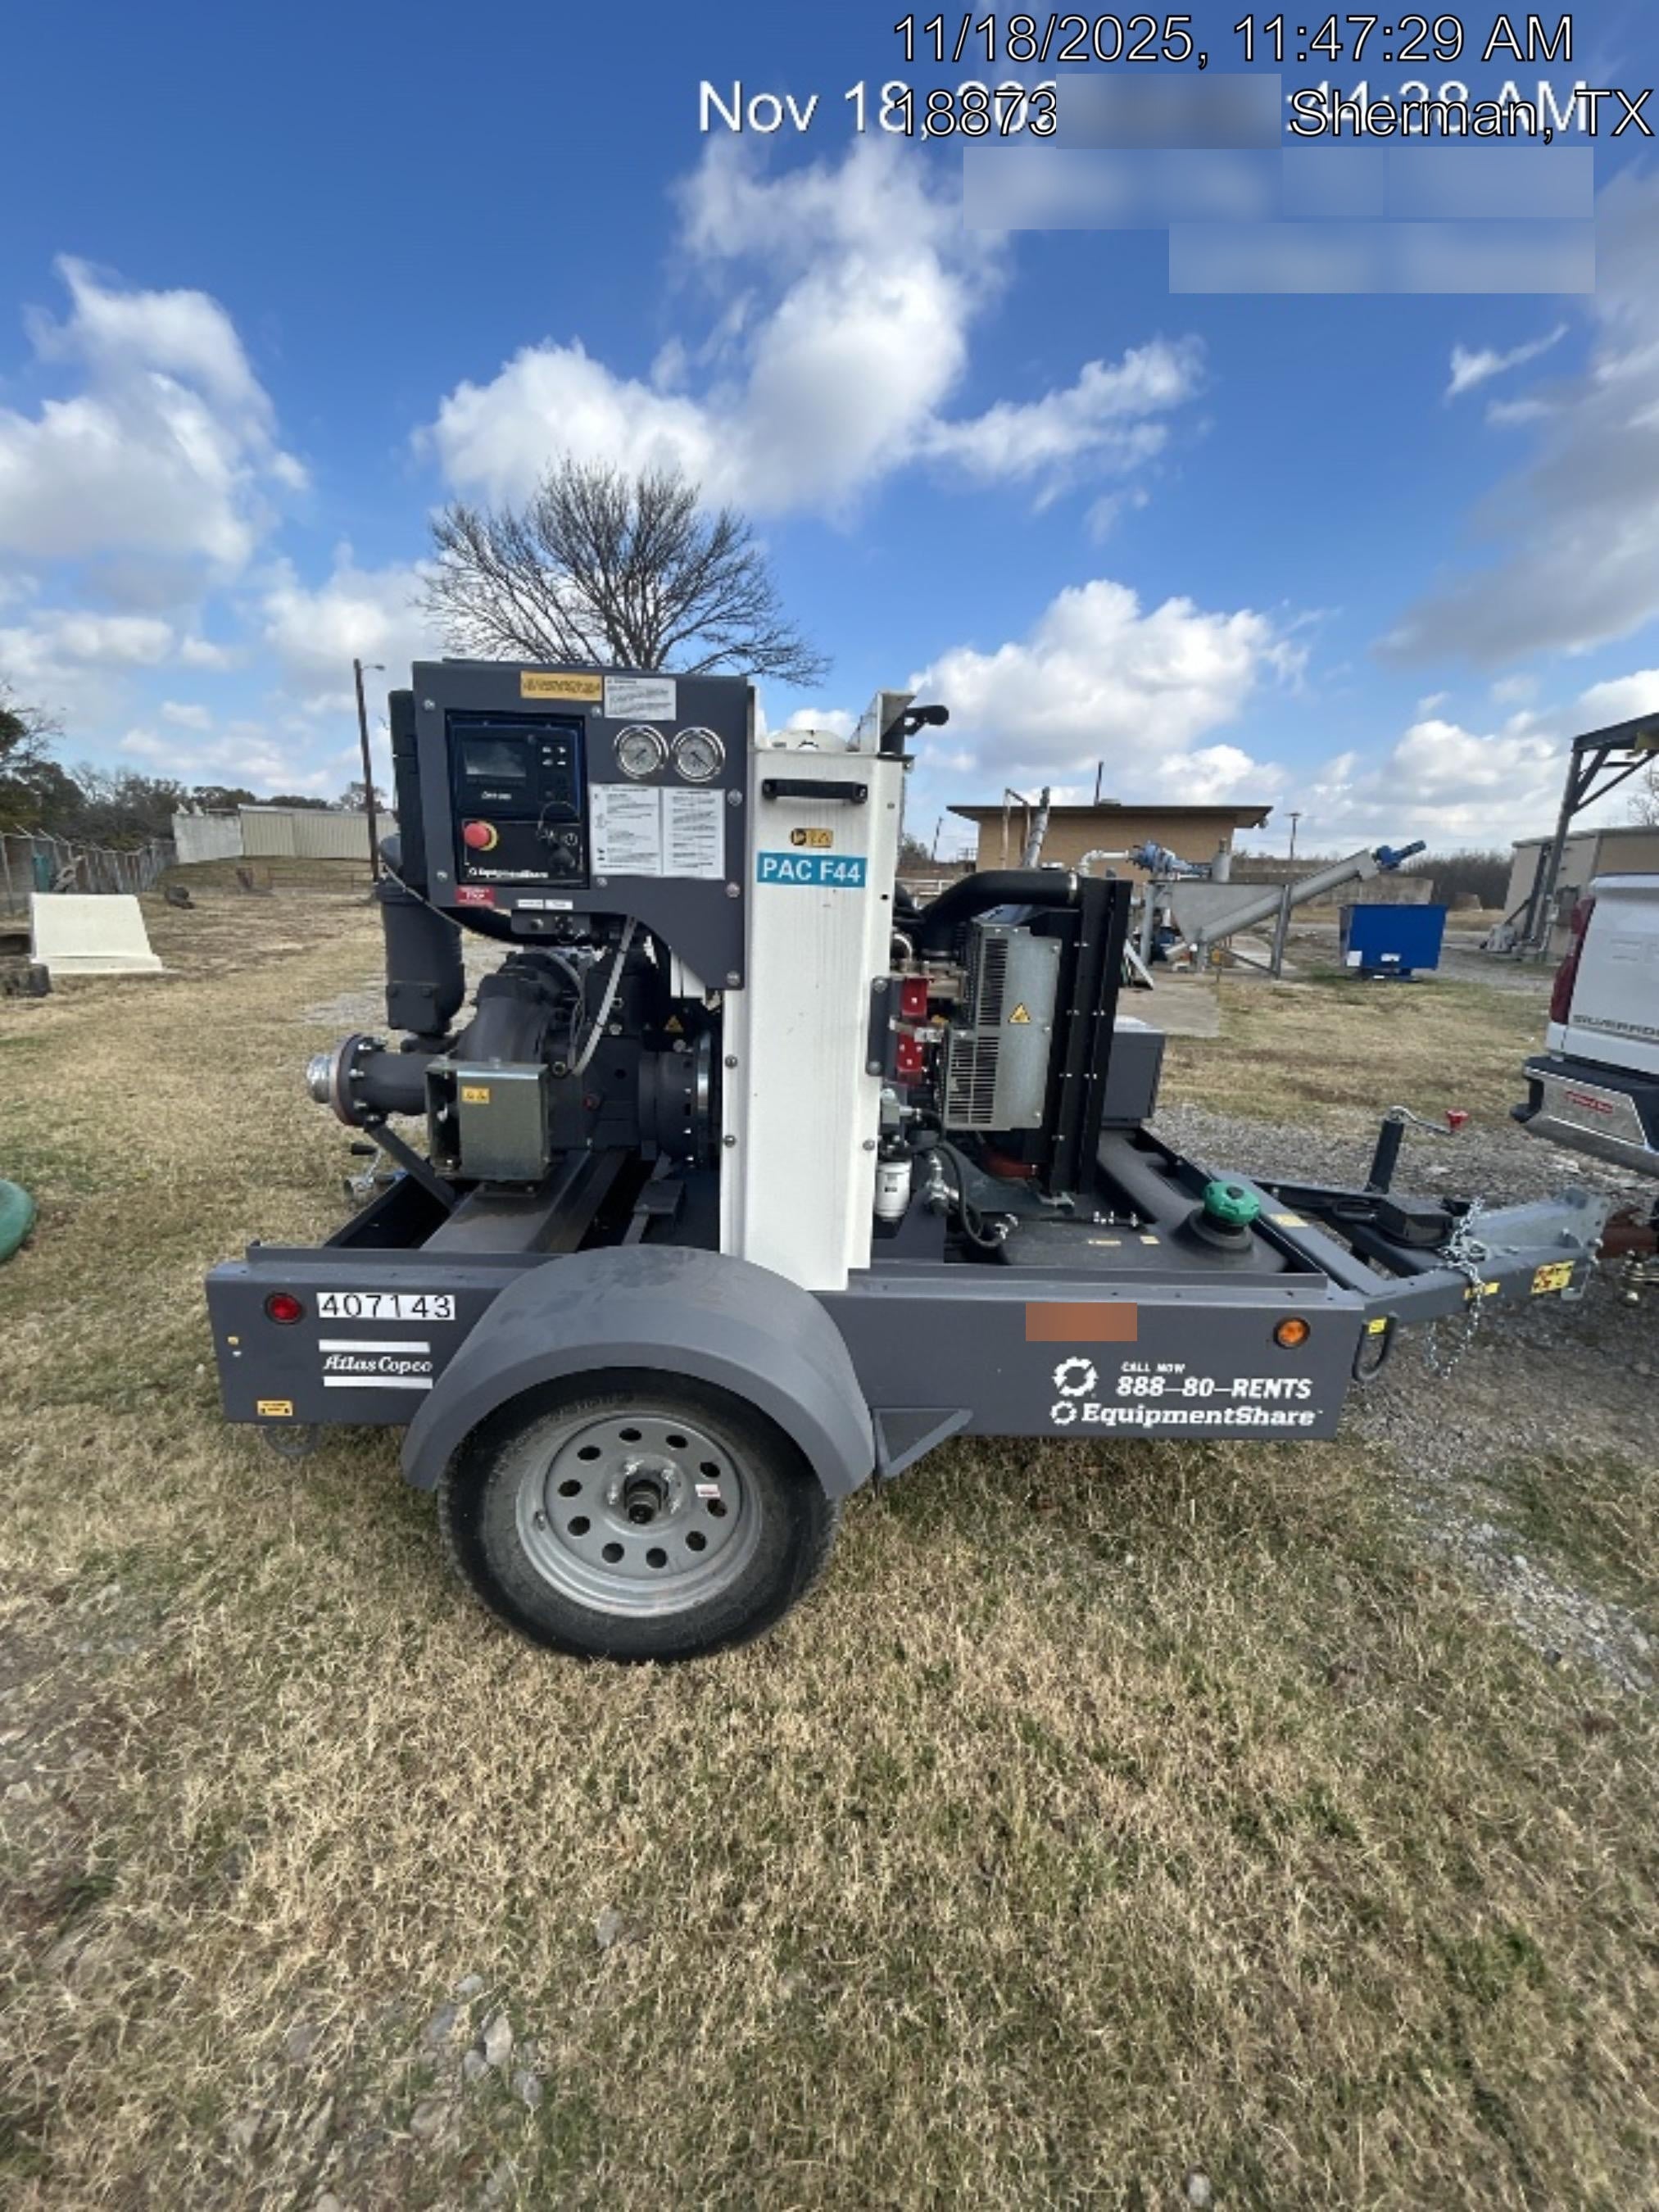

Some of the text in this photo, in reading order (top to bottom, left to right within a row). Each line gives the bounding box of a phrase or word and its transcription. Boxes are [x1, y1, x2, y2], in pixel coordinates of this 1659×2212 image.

[761, 856, 861, 884] PAC F44
[320, 1294, 453, 1320] 407143
[322, 1353, 433, 1376] Atlas Copco
[1120, 1360, 1186, 1376] CALL NOW
[1081, 1402, 1317, 1430] EquipmentShare
